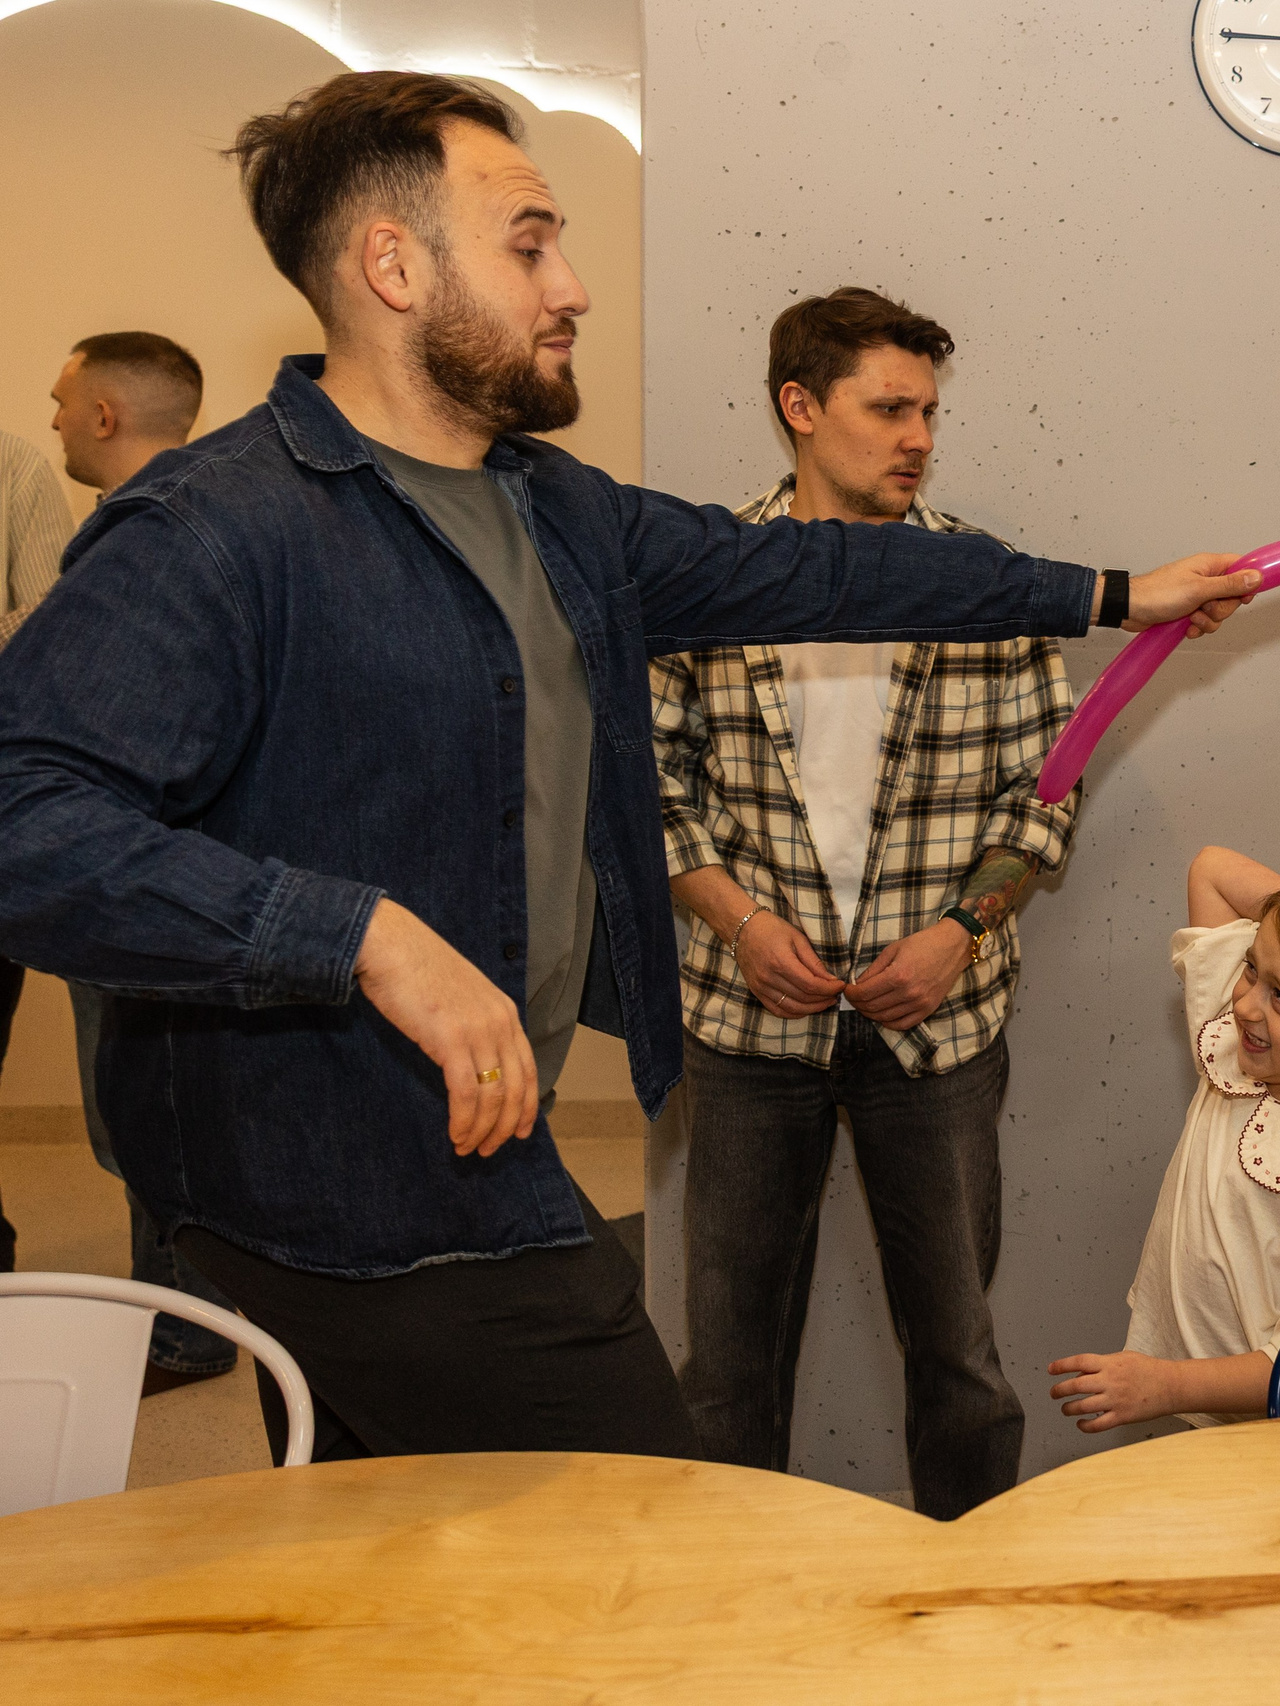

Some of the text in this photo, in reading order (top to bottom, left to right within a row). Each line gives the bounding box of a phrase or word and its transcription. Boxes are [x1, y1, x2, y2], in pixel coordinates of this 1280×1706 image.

[1220, 27, 1232, 44] 9
[1231, 65, 1243, 83] 8
[1260, 97, 1272, 114] 7
